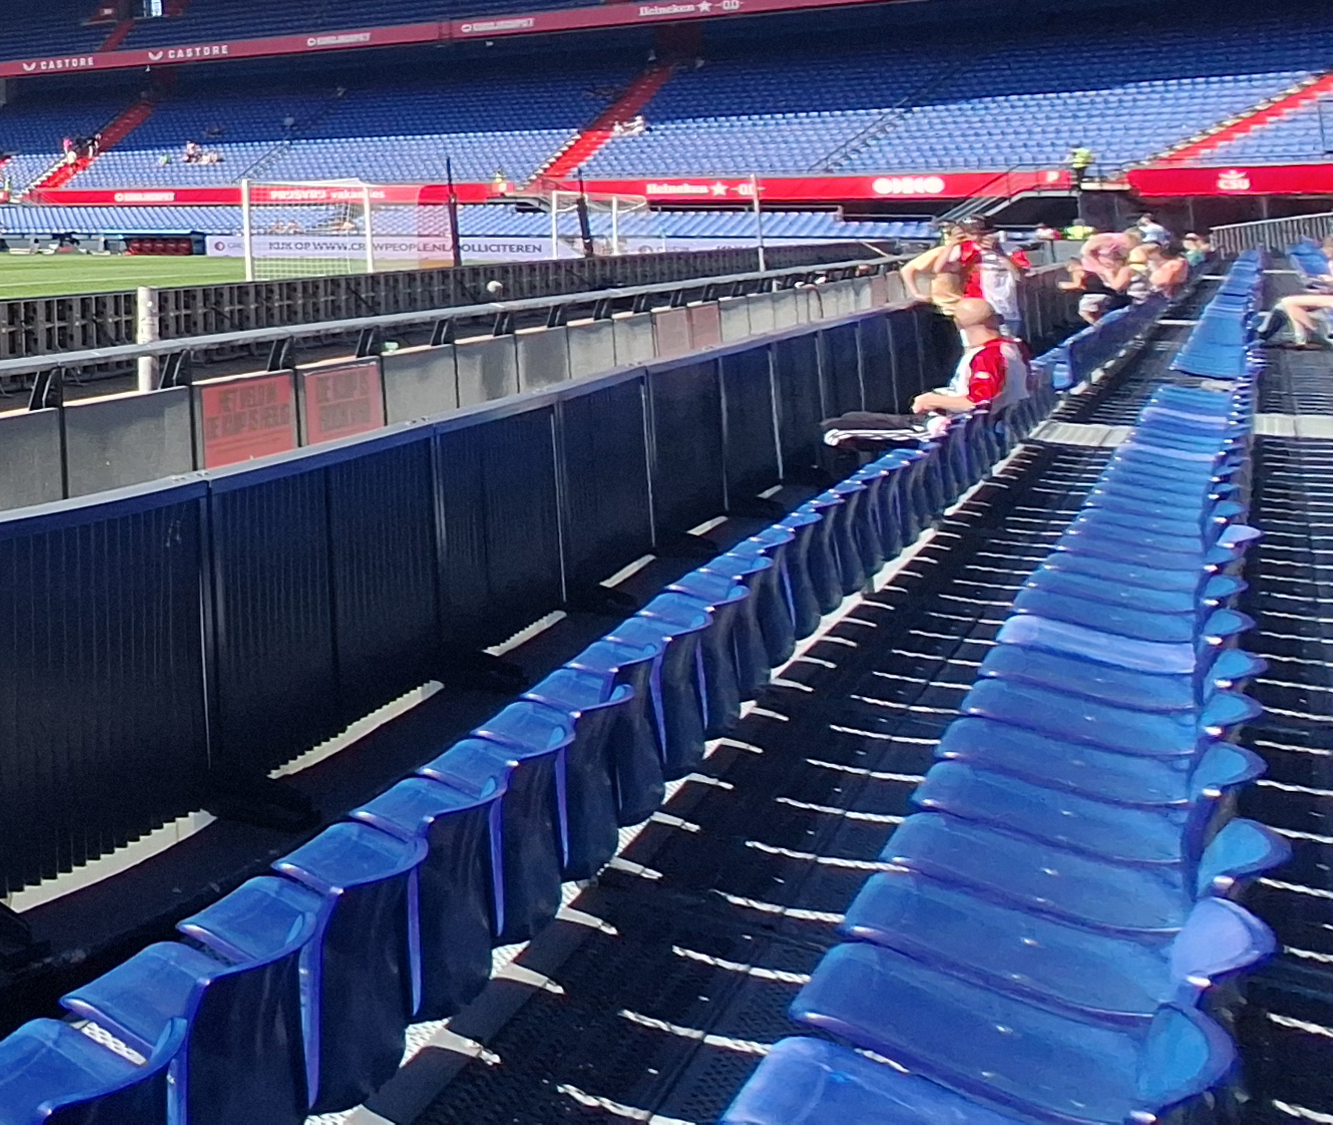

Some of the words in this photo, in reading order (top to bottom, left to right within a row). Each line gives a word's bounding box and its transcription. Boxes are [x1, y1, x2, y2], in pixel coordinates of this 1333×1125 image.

[639, 2, 695, 17] Heineken
[167, 45, 229, 59] CASTORE
[40, 57, 95, 70] CASTORE
[646, 183, 709, 195] Heineken
[1216, 177, 1250, 190] CSU
